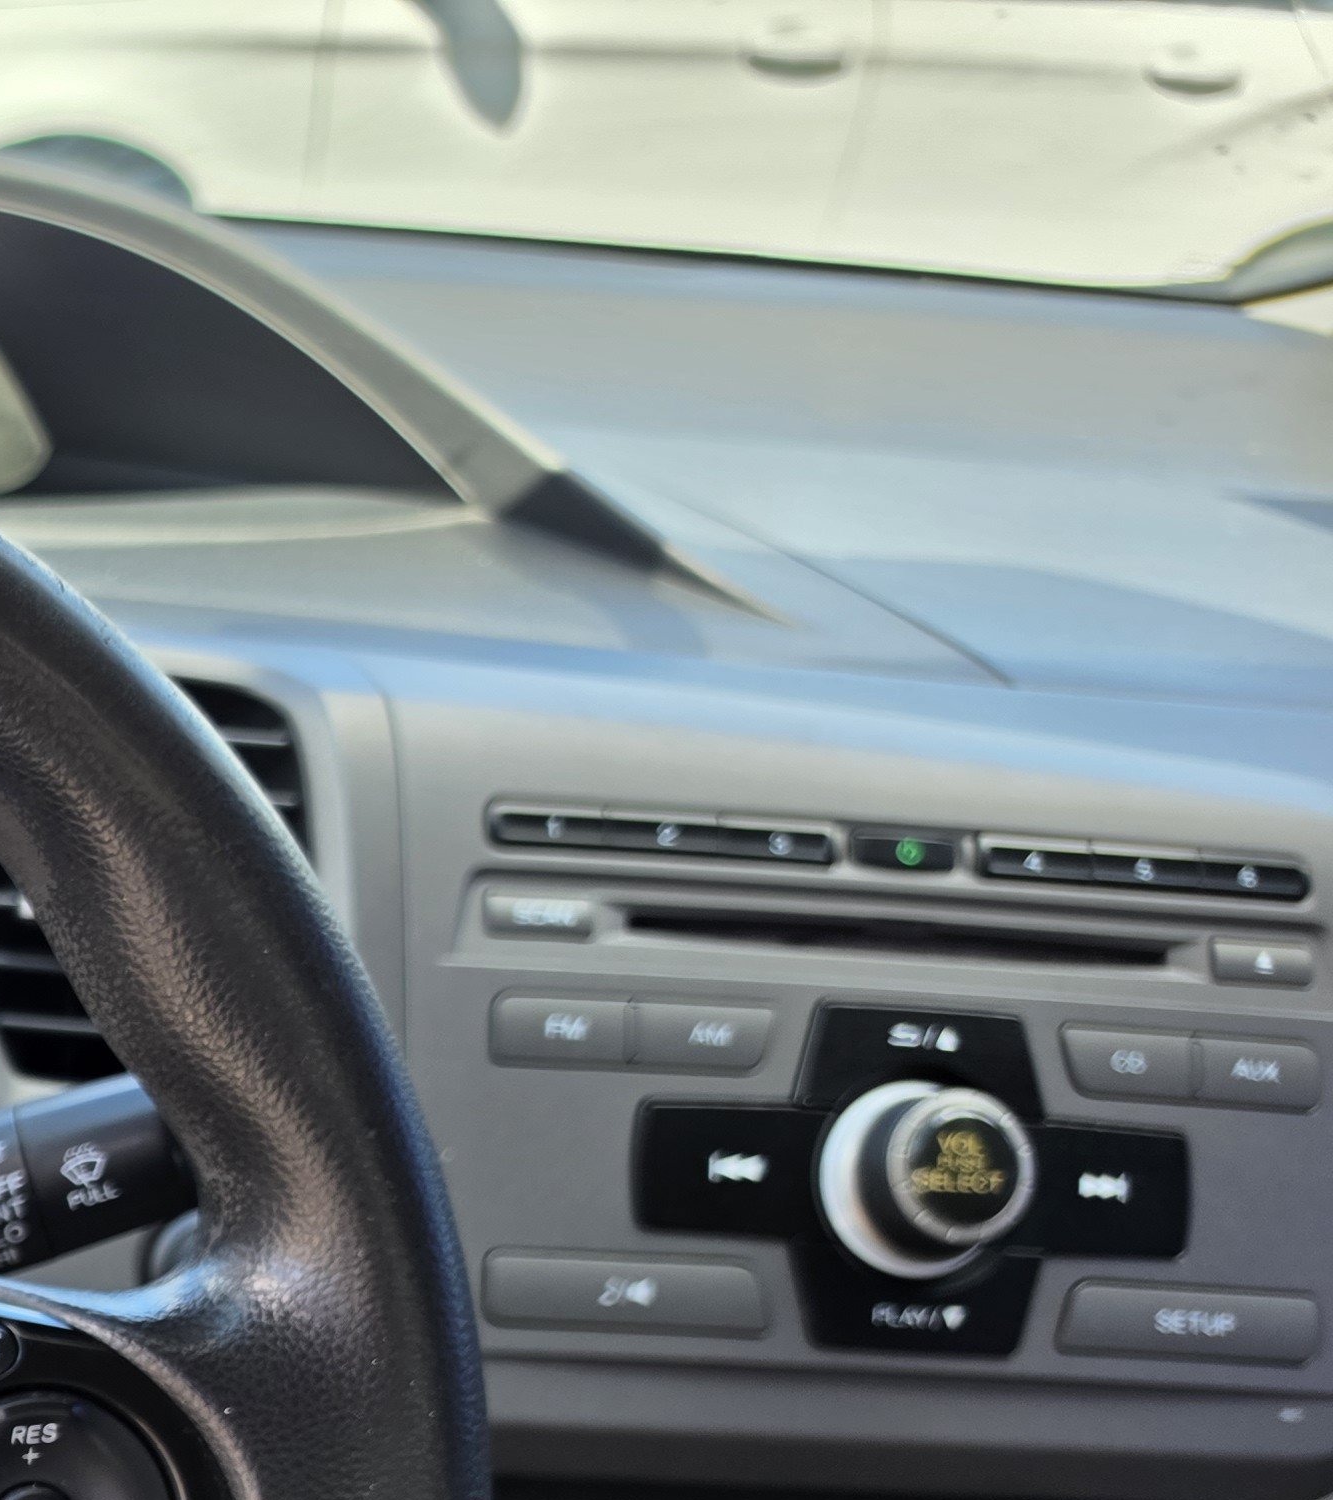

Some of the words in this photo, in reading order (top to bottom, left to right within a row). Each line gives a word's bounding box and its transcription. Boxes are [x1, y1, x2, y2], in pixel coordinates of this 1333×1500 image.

[688, 1019, 733, 1047] AM
[66, 1180, 122, 1212] PULL
[1154, 1307, 1237, 1338] SETUP
[11, 1422, 60, 1445] RES
